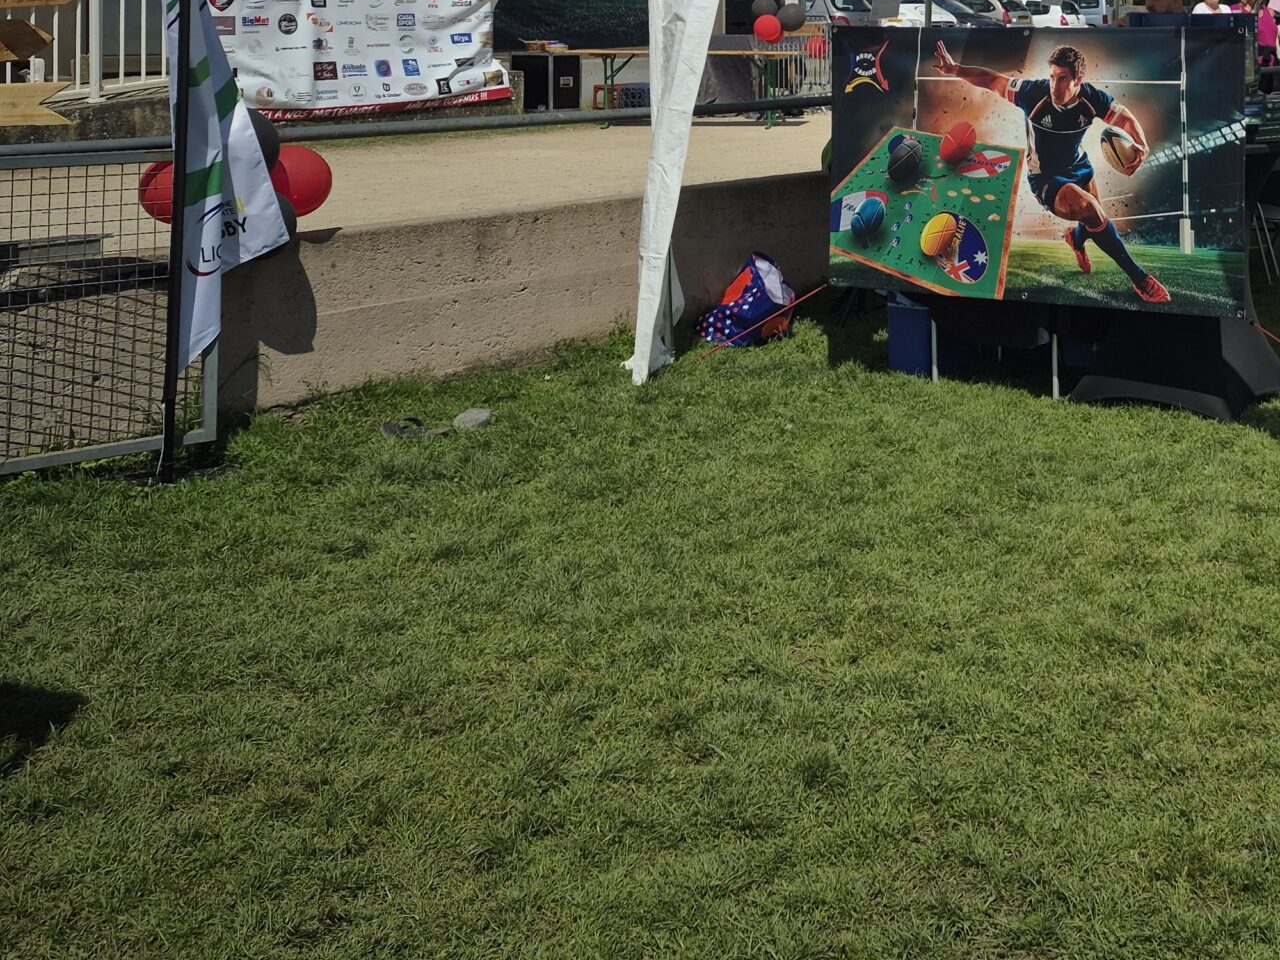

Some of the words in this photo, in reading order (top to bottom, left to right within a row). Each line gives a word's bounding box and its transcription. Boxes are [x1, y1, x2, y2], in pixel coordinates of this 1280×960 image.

[242, 16, 270, 27] BigMat
[453, 33, 469, 42] Krys
[285, 109, 308, 119] NOS
[310, 105, 380, 119] PARTENAIRES
